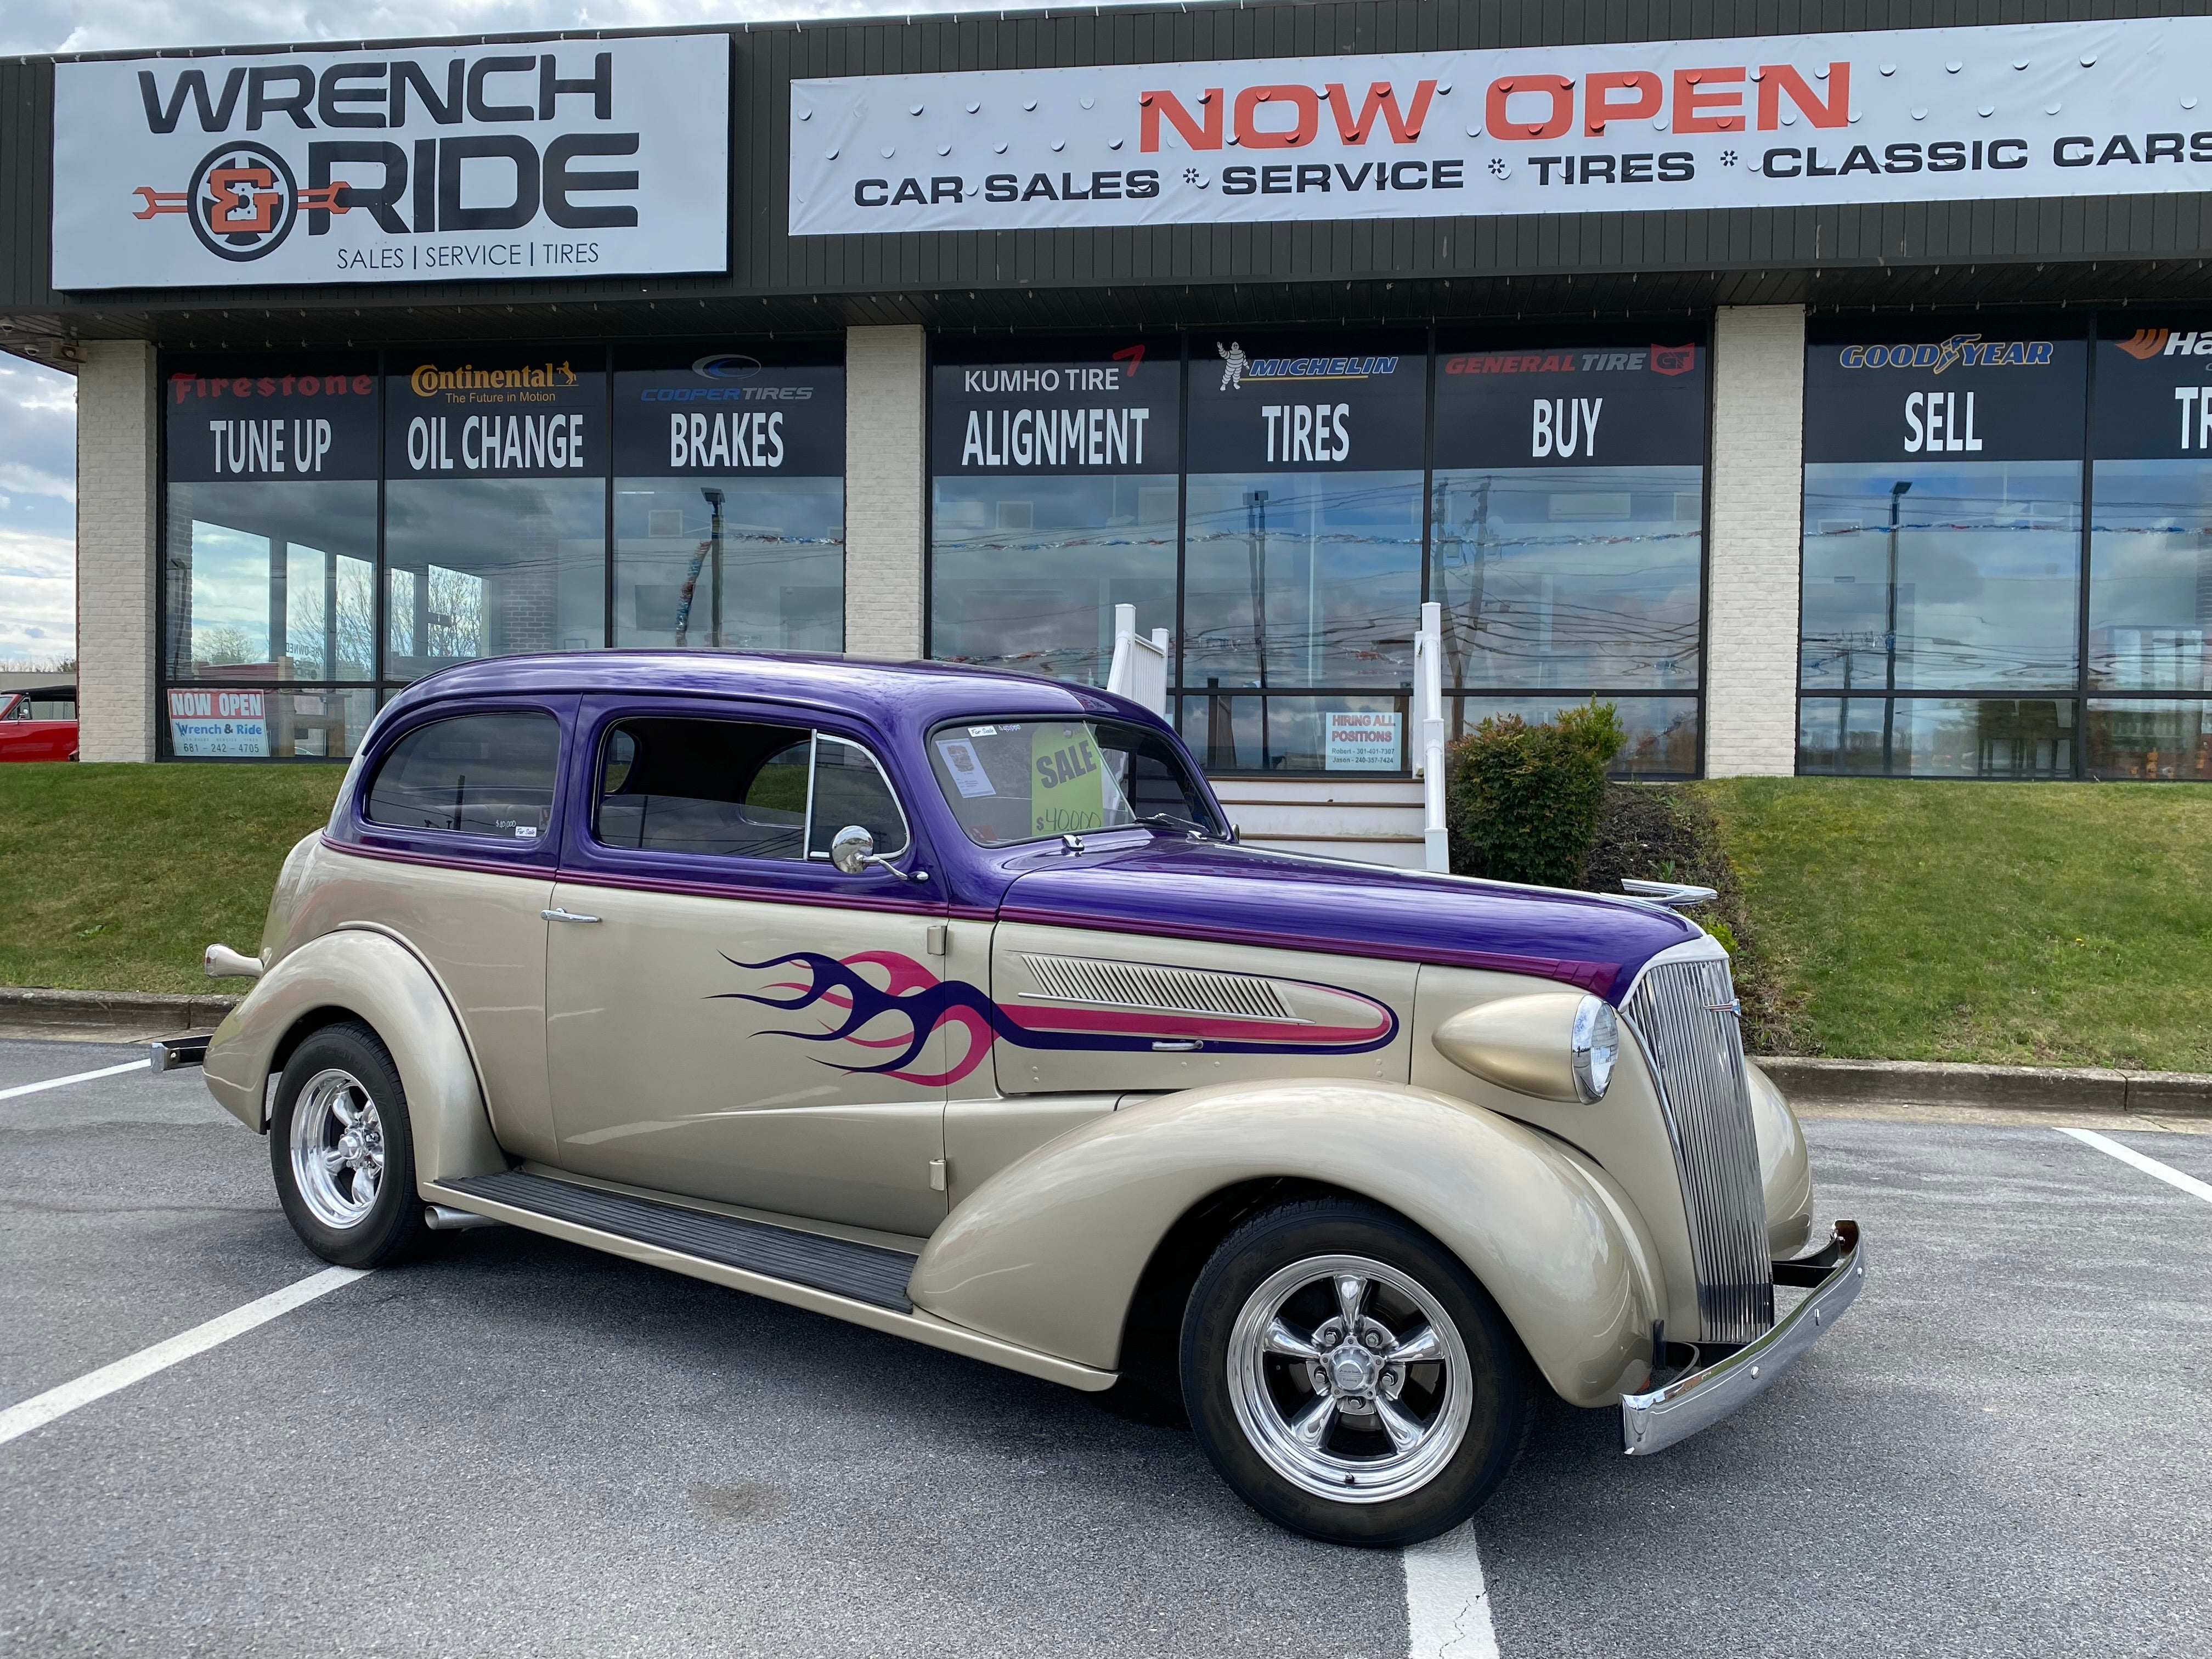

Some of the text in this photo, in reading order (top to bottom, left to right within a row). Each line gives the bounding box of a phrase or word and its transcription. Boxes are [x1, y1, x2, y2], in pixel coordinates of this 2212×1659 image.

[137, 52, 613, 134] WRENCH
[1140, 61, 1851, 153] NOW OPEN
[308, 133, 640, 235] RIDE
[854, 131, 2212, 207] CAR SALES SERVICE TIRES CLASSIC CARS
[337, 247, 404, 269] SALES
[425, 244, 521, 268] SERVICE
[543, 242, 599, 264] TIRES
[410, 363, 554, 397] Continental
[964, 368, 1120, 392] KUMHO TIRE
[1248, 356, 1400, 376] MICHELIN
[1445, 354, 1576, 374] GENERAL
[1581, 353, 1647, 371] TIRE
[170, 373, 373, 404] Firestone
[445, 390, 555, 404] The Future in Motion
[408, 414, 583, 470] OIL CHANGE
[670, 411, 784, 467] BRAKES
[961, 408, 1149, 466] ALIGNMENT
[1262, 403, 1350, 462] TIRES
[1532, 398, 1603, 458] BUY
[1904, 392, 1983, 453] SELL
[210, 419, 331, 473] TUNE UP
[171, 692, 262, 716] NOW OPEN
[1332, 715, 1396, 727] HIRING ALL
[176, 722, 262, 737] Wrench & Ride
[184, 743, 199, 752] 681
[211, 743, 227, 753] 242
[239, 744, 259, 753] 4705
[1331, 730, 1392, 742] POSITIONS
[1035, 740, 1098, 789] SALE
